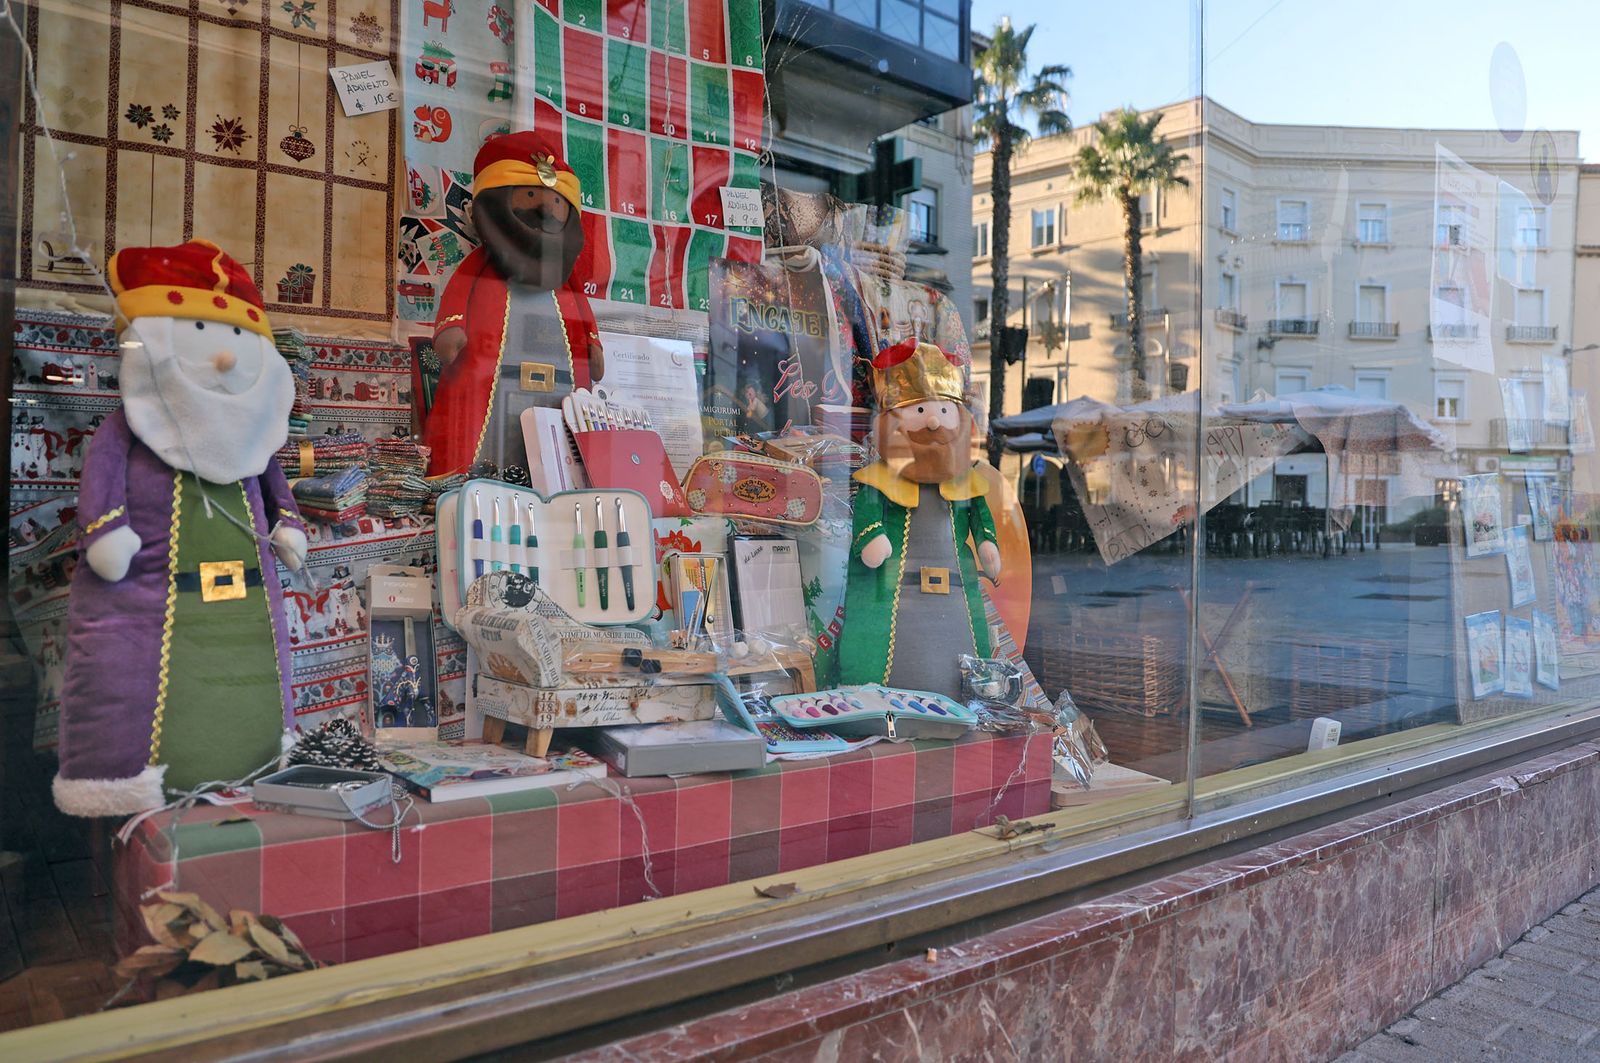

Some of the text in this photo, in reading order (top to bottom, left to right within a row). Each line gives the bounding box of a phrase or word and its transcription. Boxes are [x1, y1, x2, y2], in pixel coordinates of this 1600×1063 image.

[579, 14, 586, 26] 2
[622, 27, 629, 38] 3
[702, 49, 709, 60] 5
[745, 55, 752, 66] 6
[338, 70, 375, 82] PANEL
[347, 80, 389, 94] ADVIENTO
[547, 86, 755, 150] 7 8 9 10 11 12
[726, 190, 749, 199] PANEL
[581, 193, 593, 205] 14
[621, 202, 634, 214] 15
[664, 210, 677, 221] 16
[705, 214, 718, 226] 17
[584, 282, 597, 295] 20
[621, 288, 634, 300] 21
[660, 294, 672, 306] 22
[612, 351, 650, 361] Certificado
[708, 416, 737, 427] PORTAL
[541, 692, 554, 701] 17
[542, 703, 553, 712] 18
[540, 714, 552, 723] 19
